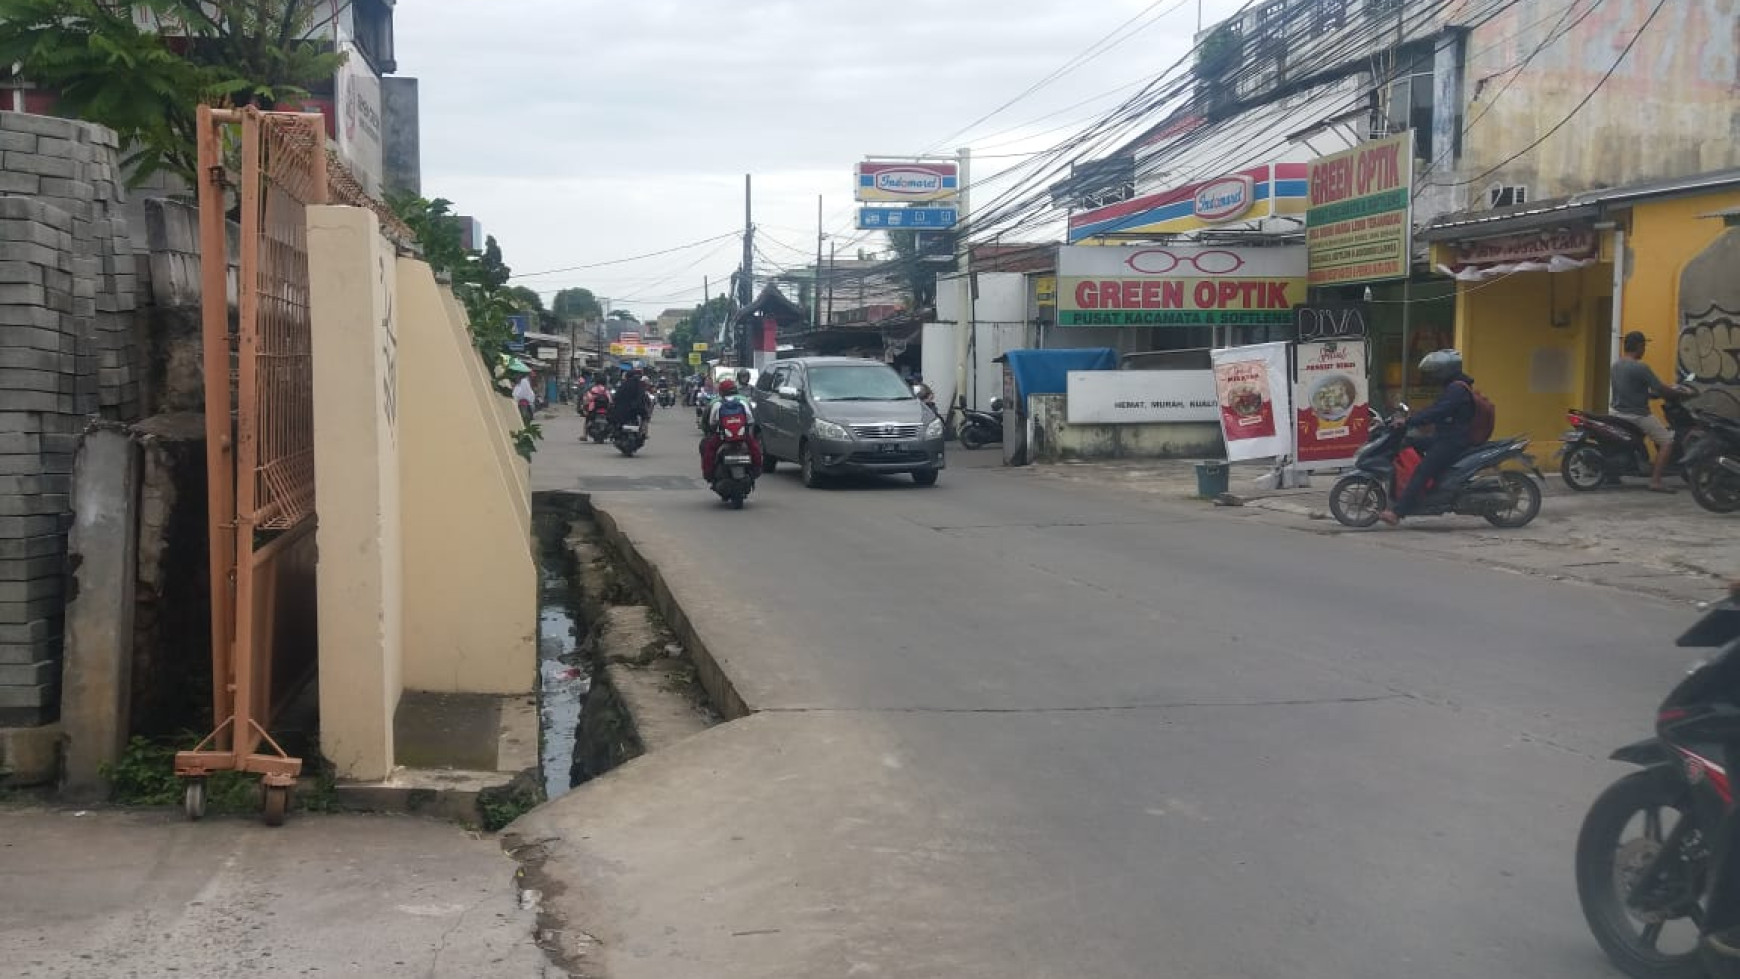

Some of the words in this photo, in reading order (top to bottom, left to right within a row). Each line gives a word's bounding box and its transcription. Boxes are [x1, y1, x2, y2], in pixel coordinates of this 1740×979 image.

[880, 175, 936, 188] Indomaret
[1311, 156, 1354, 206] GREEN
[1357, 142, 1401, 196] OPTIK
[1198, 186, 1243, 212] Indomaret
[1075, 280, 1184, 309] GREEN
[1193, 280, 1290, 309] OPTIK
[1073, 312, 1121, 325] PUSAT
[1124, 312, 1201, 325] KACAMATA
[1204, 312, 1215, 324] &
[1220, 312, 1293, 325] SOFTLENS
